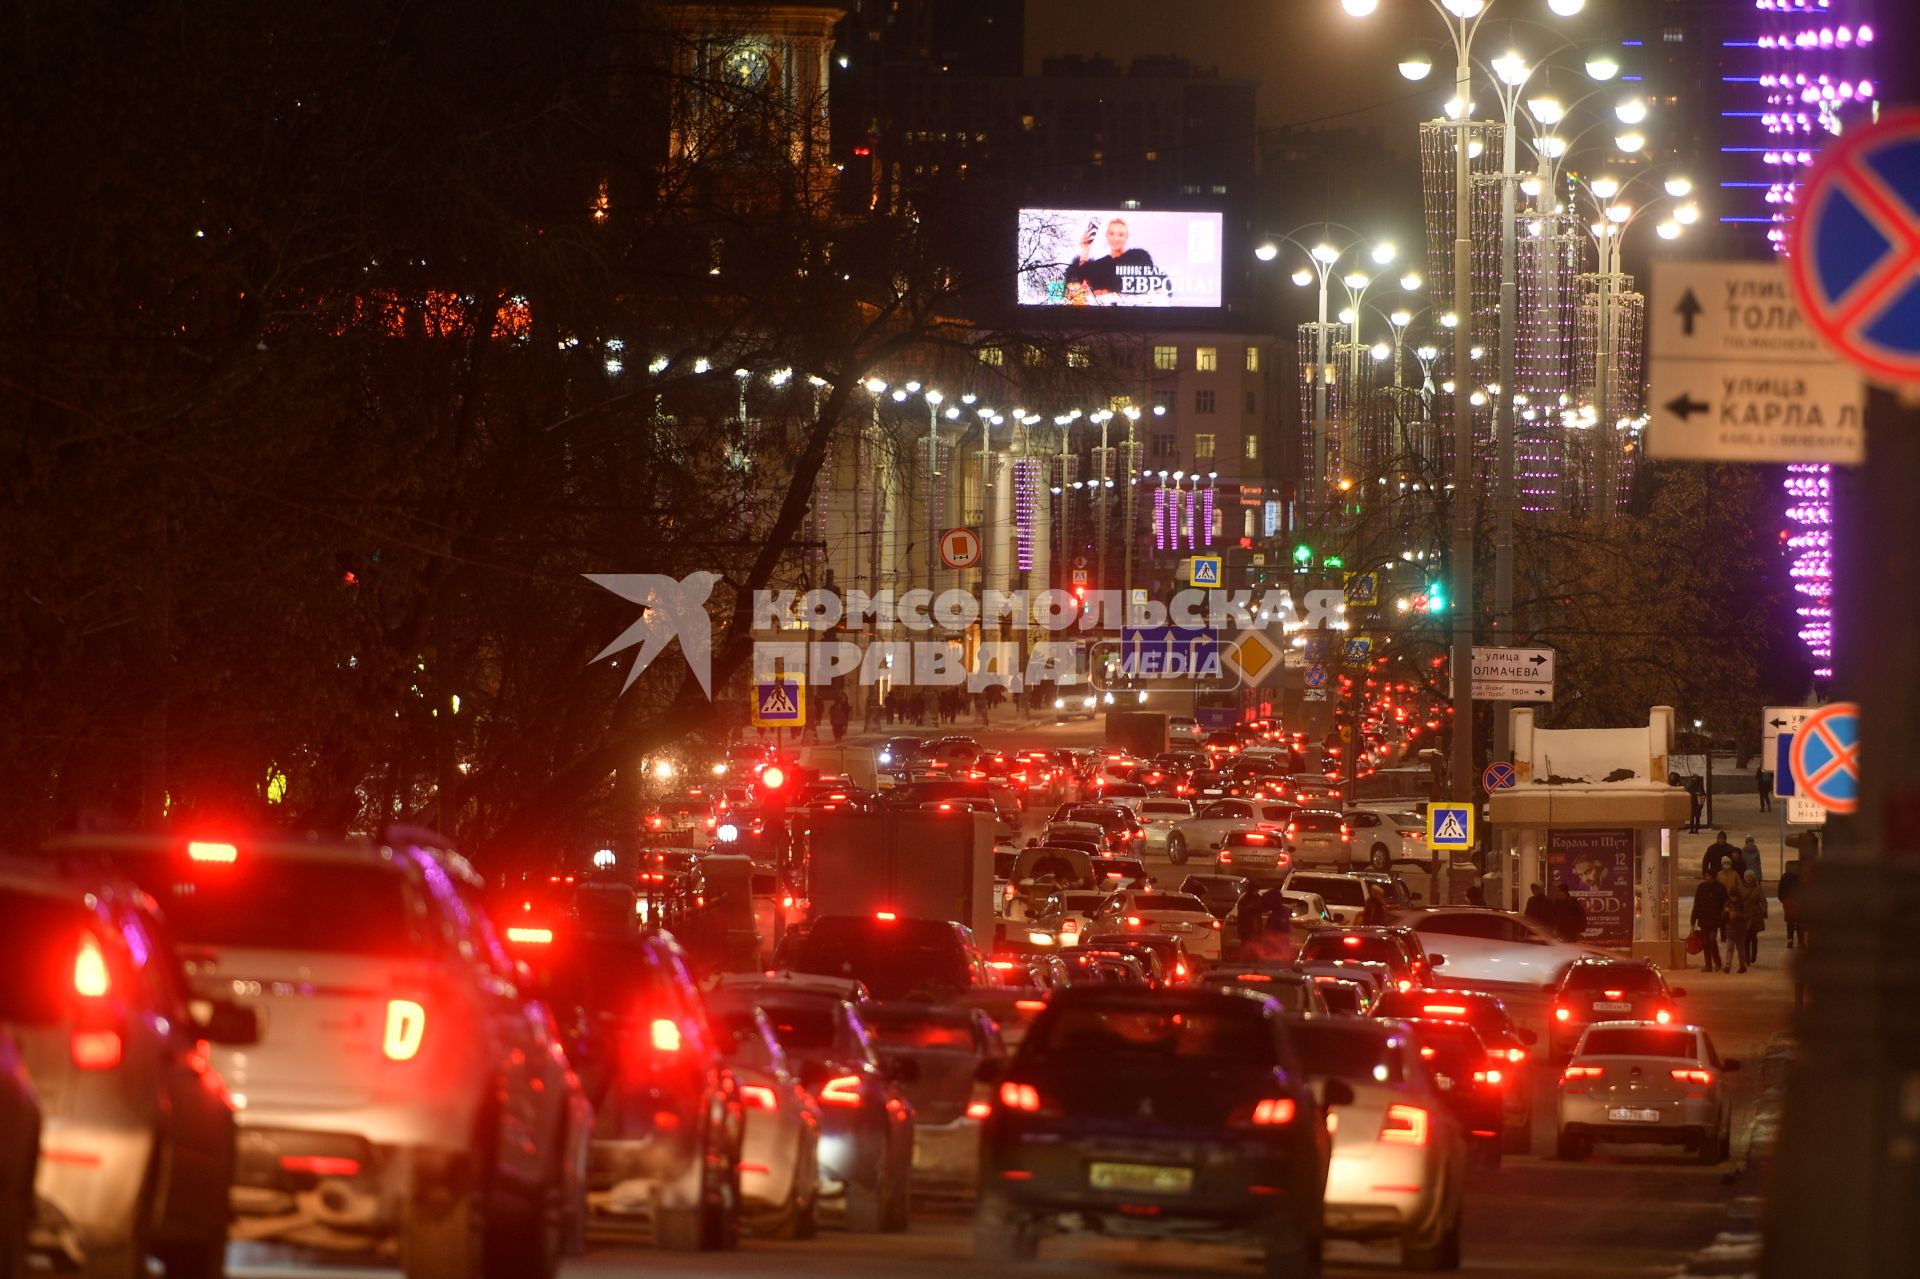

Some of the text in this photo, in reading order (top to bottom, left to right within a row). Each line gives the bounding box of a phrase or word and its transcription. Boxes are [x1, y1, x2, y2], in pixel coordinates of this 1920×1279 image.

[1720, 402, 1824, 427] КАРЛА
[1486, 653, 1519, 661] улица
[1474, 667, 1539, 677] ОЛМАЧЕВА
[1552, 837, 1588, 850] Король
[1601, 837, 1628, 849] Шут
[1615, 853, 1626, 865] 12
